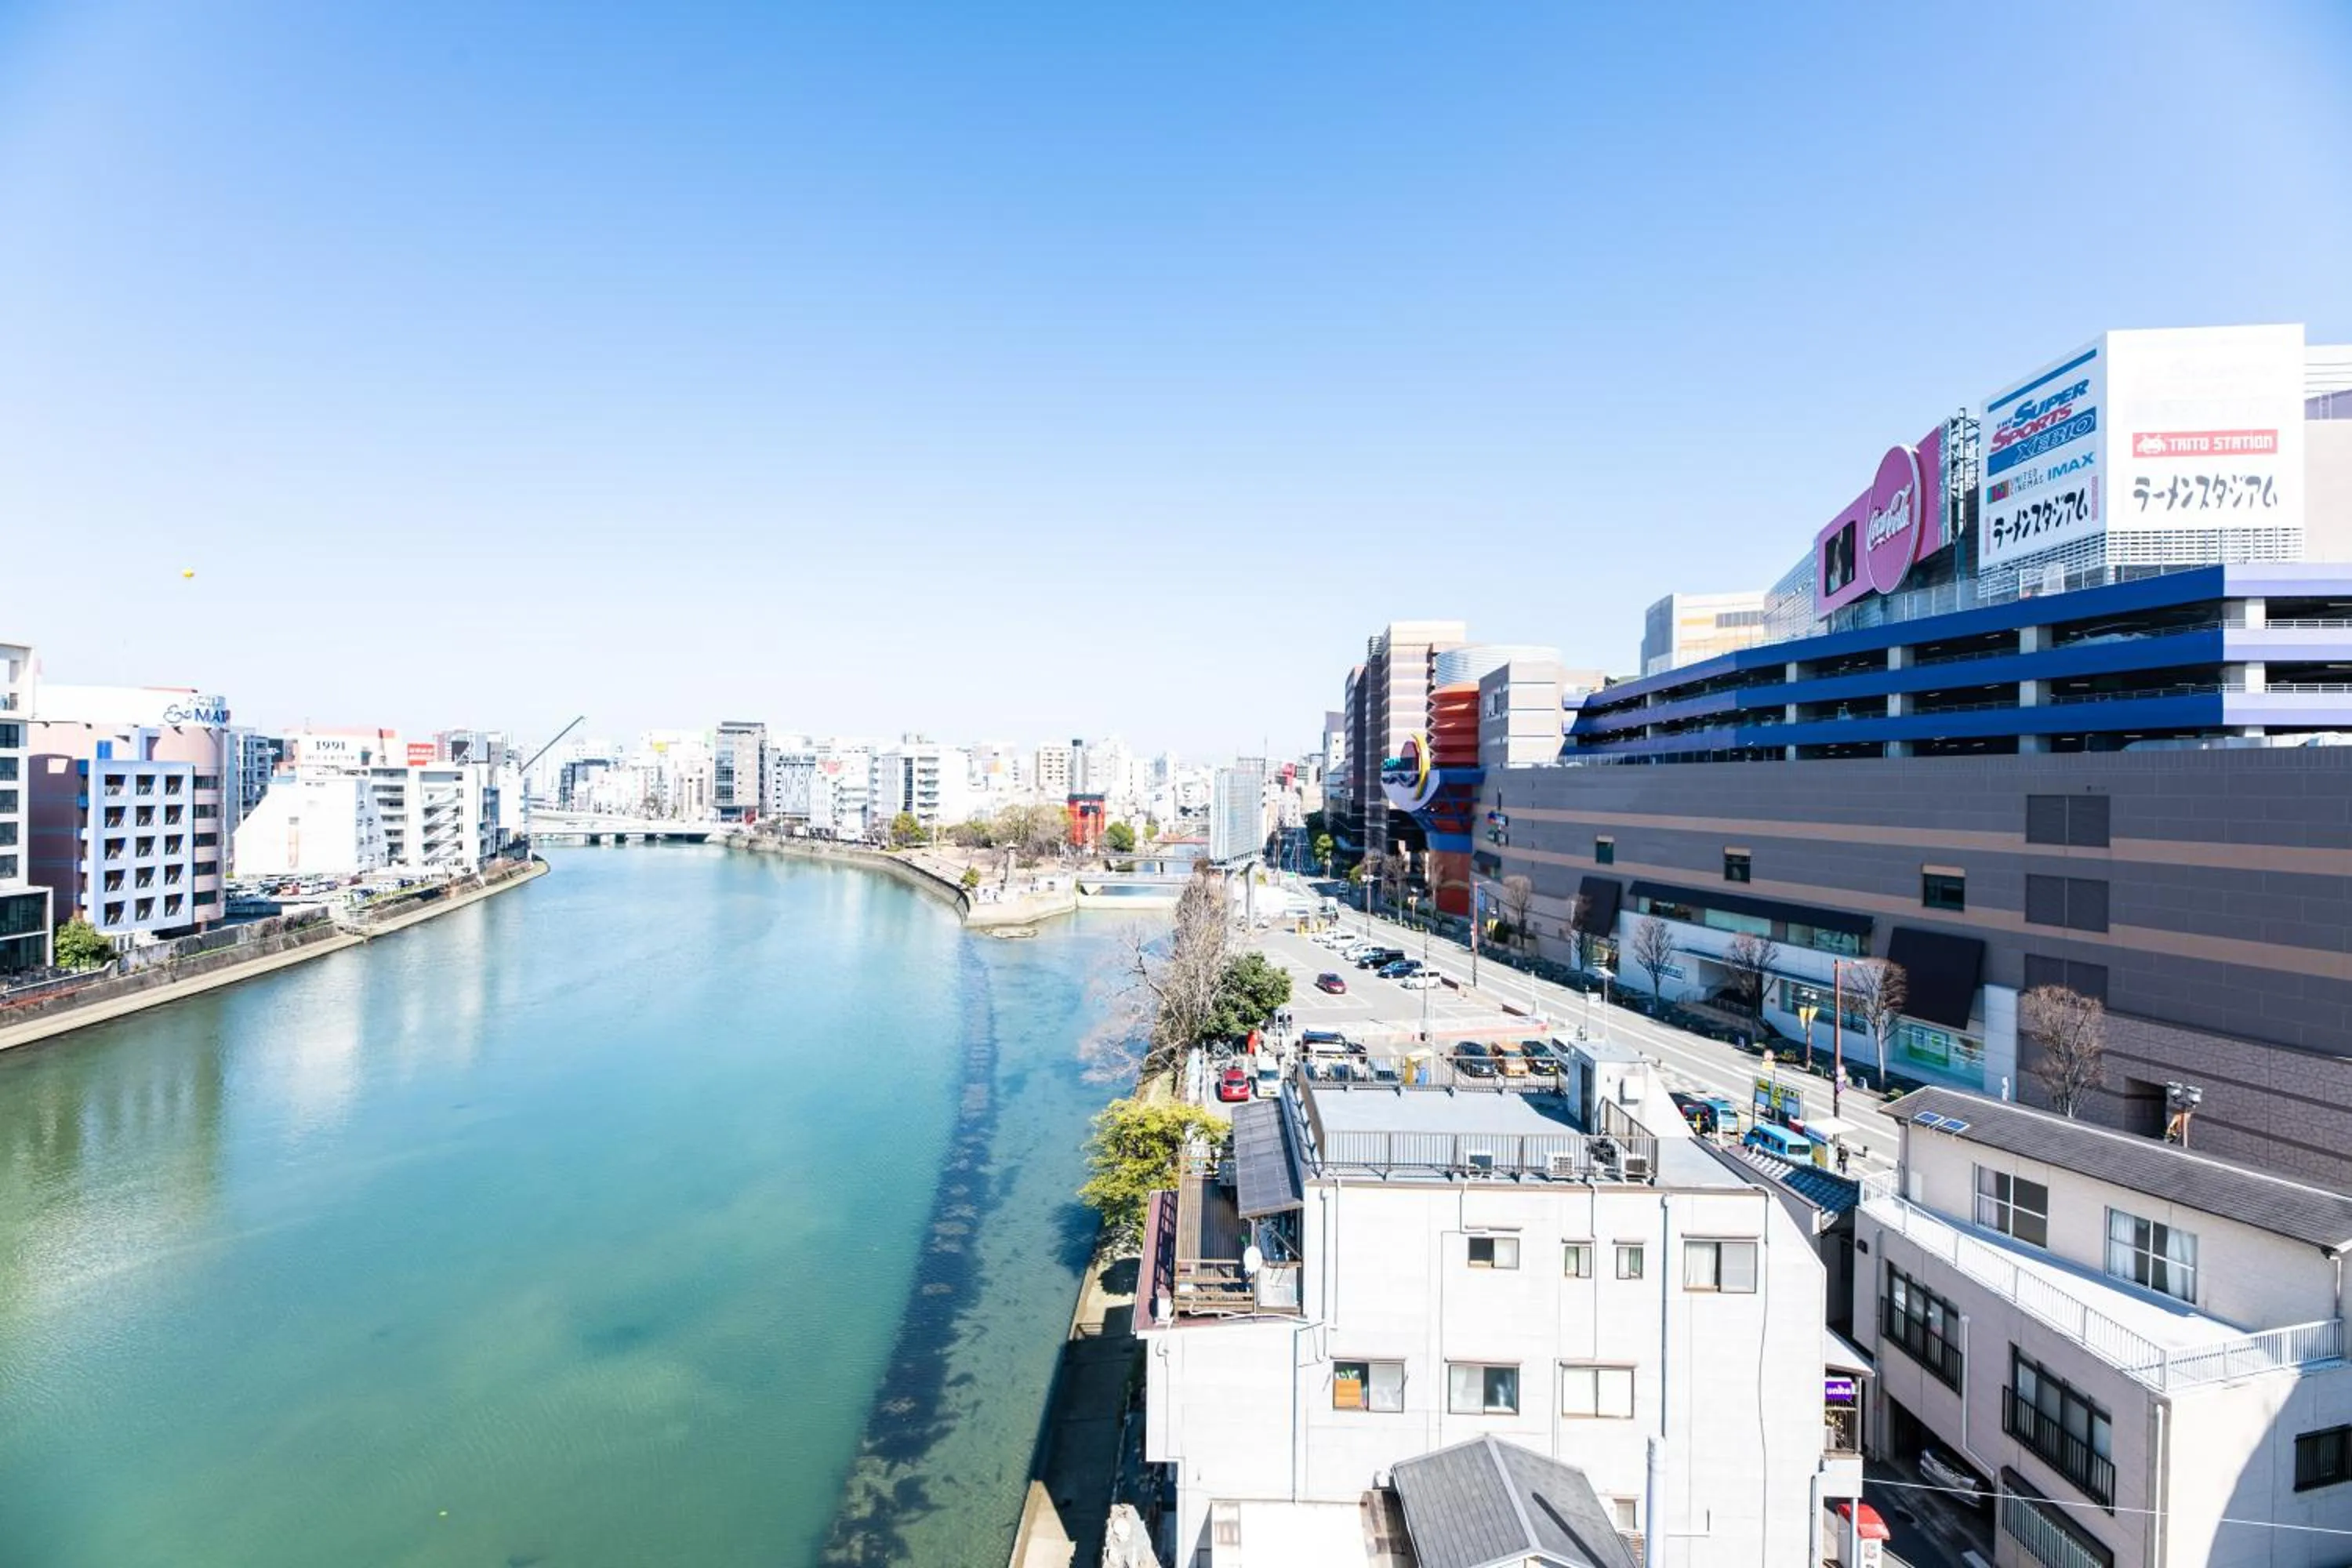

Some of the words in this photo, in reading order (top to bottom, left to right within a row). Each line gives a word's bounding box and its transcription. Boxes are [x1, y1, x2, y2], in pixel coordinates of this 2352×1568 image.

[2013, 379, 2089, 428] SUPER
[1990, 402, 2074, 452] SPORTS
[2014, 414, 2095, 465] XEBIO
[2170, 437, 2209, 452] TAITO
[2213, 434, 2274, 452] STATION
[2010, 476, 2045, 495] CINEMAS
[2047, 451, 2095, 482] IMAX
[2132, 470, 2279, 514] ラーメンスタジアム
[1993, 487, 2089, 550] ラーメンスタジアム
